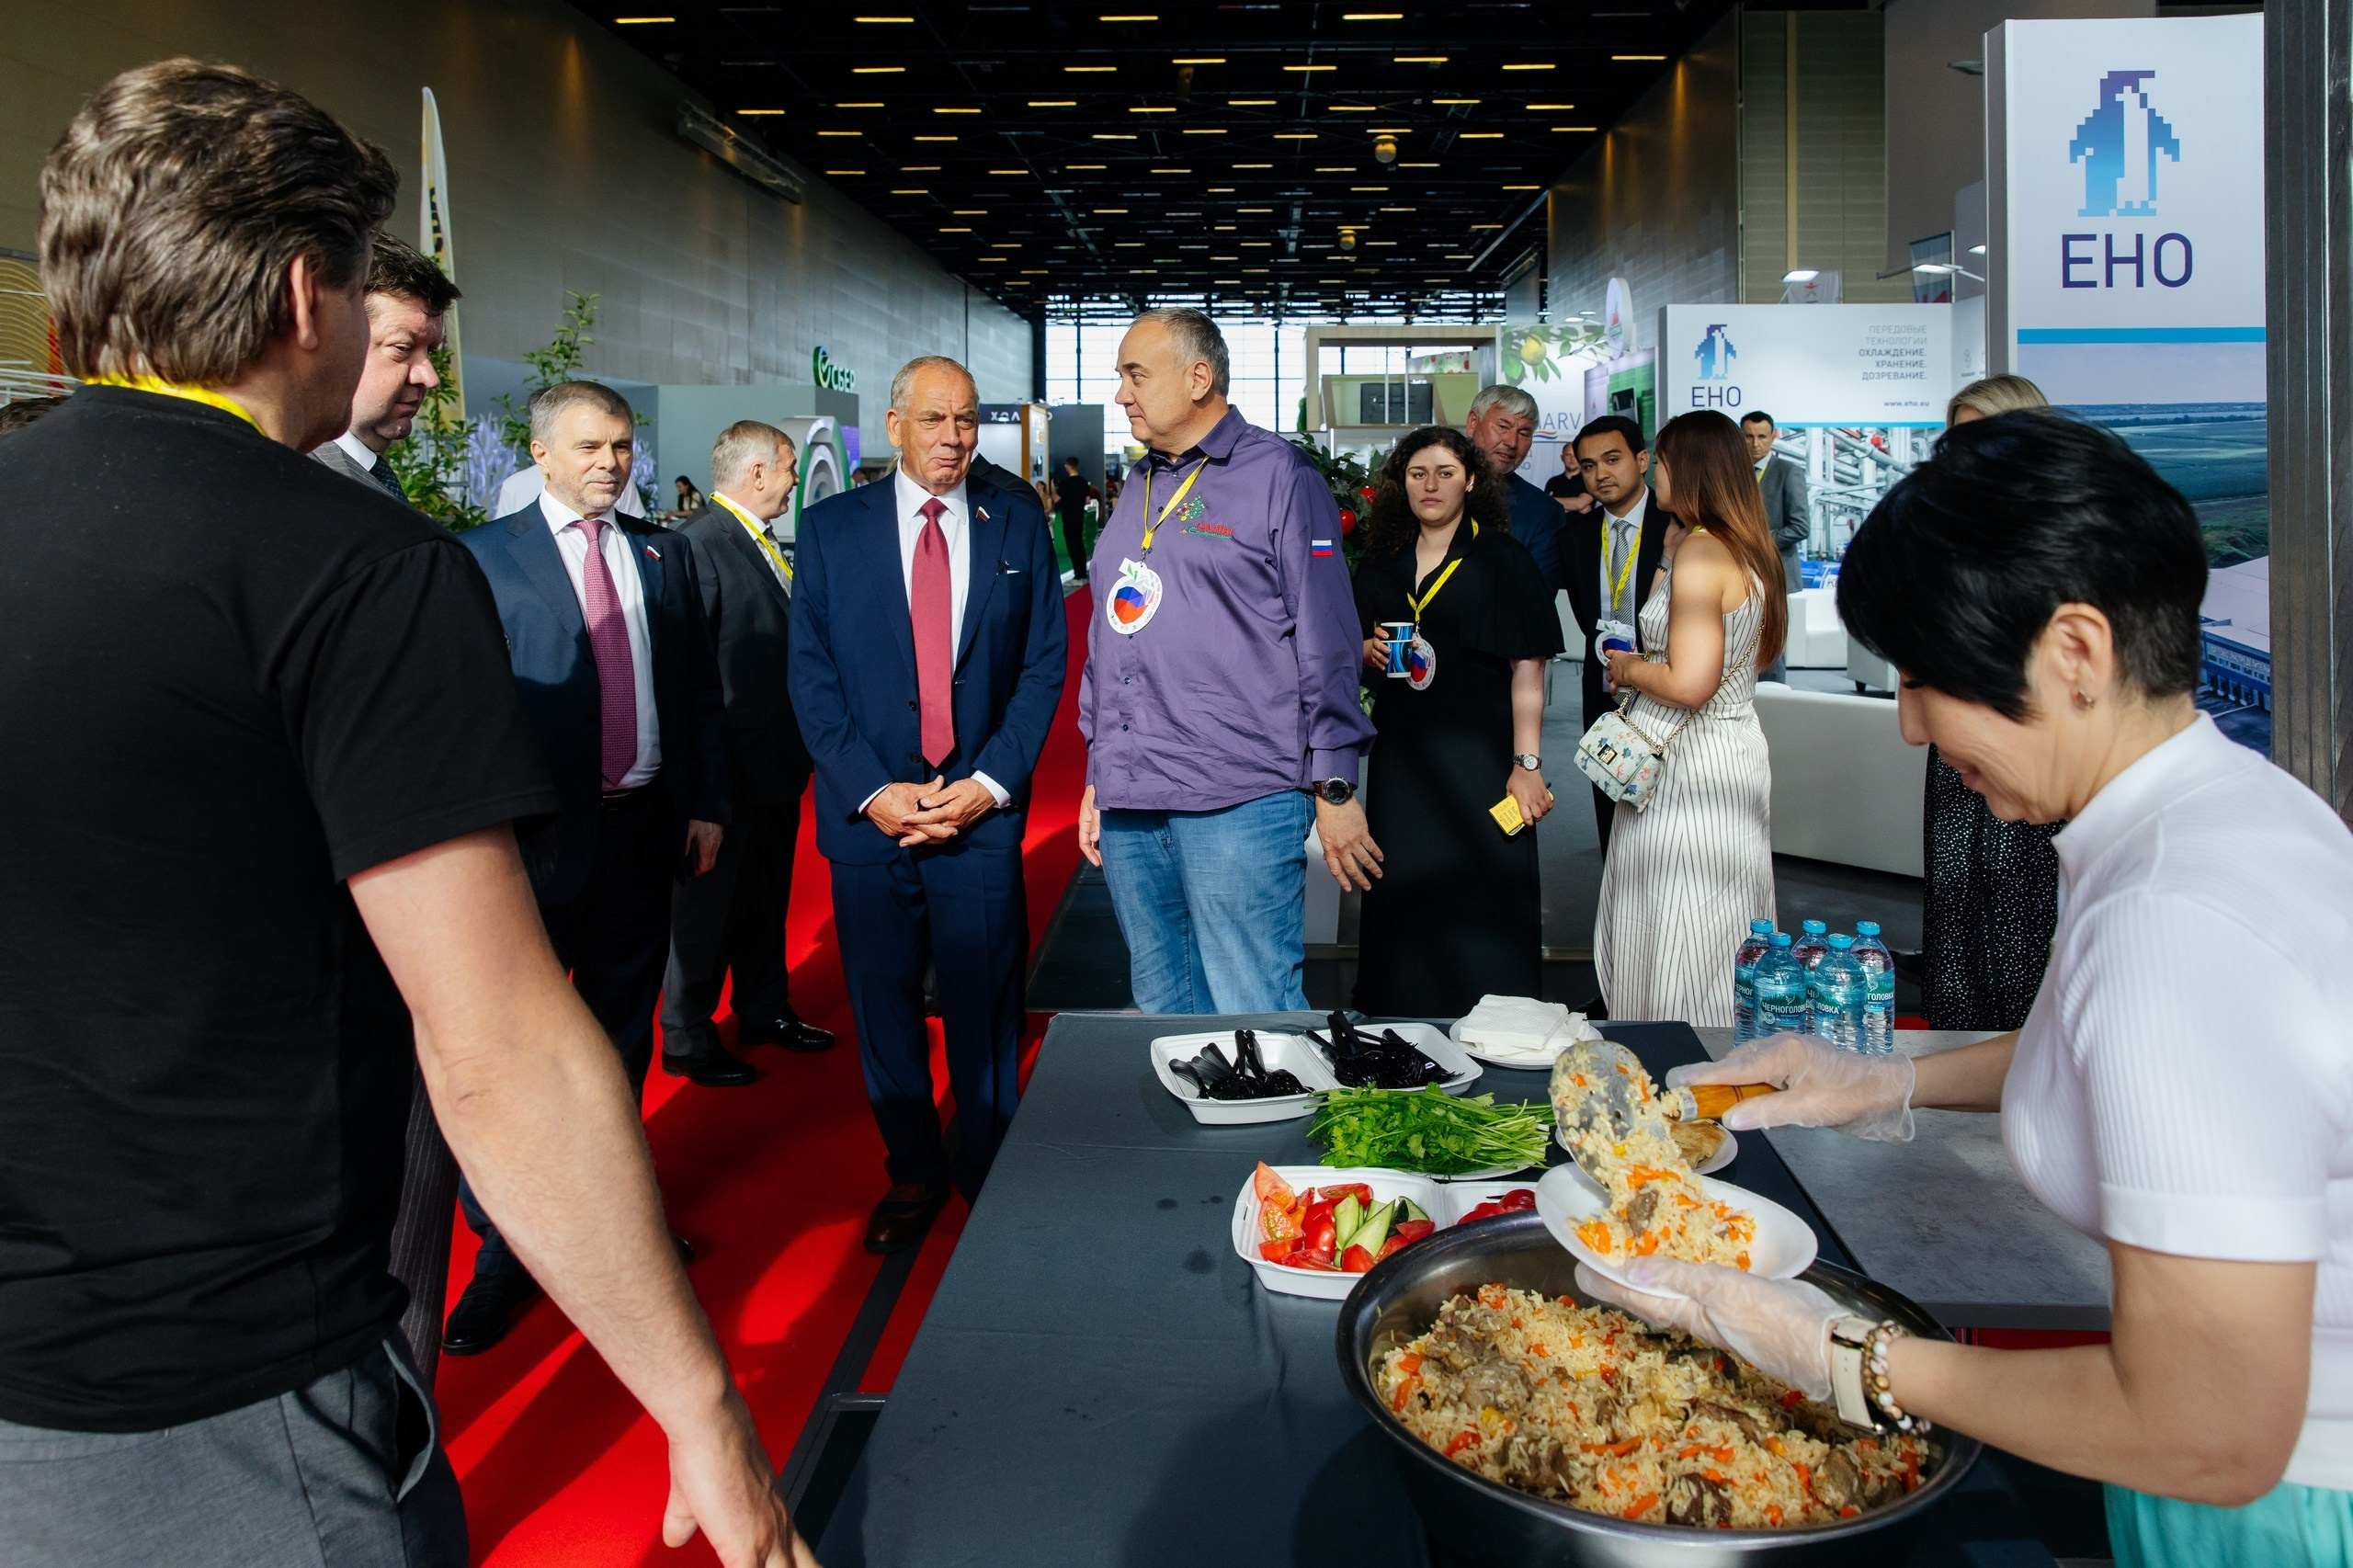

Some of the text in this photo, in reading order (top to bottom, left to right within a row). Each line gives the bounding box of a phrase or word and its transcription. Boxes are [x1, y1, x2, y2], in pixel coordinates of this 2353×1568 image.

[1869, 324, 1927, 334] ПЕРЕДОВЫЕ
[1866, 336, 1927, 346] ТЕХНОЛОГИИ
[1859, 347, 1928, 358] ОХЛАЖДЕНИЕ.
[1875, 359, 1928, 369] ХРАНЕНИЕ.
[831, 364, 856, 393] СБЕР
[1861, 371, 1928, 381] ДОЗРЕВАНИЕ.
[1539, 412, 1582, 430] ARV
